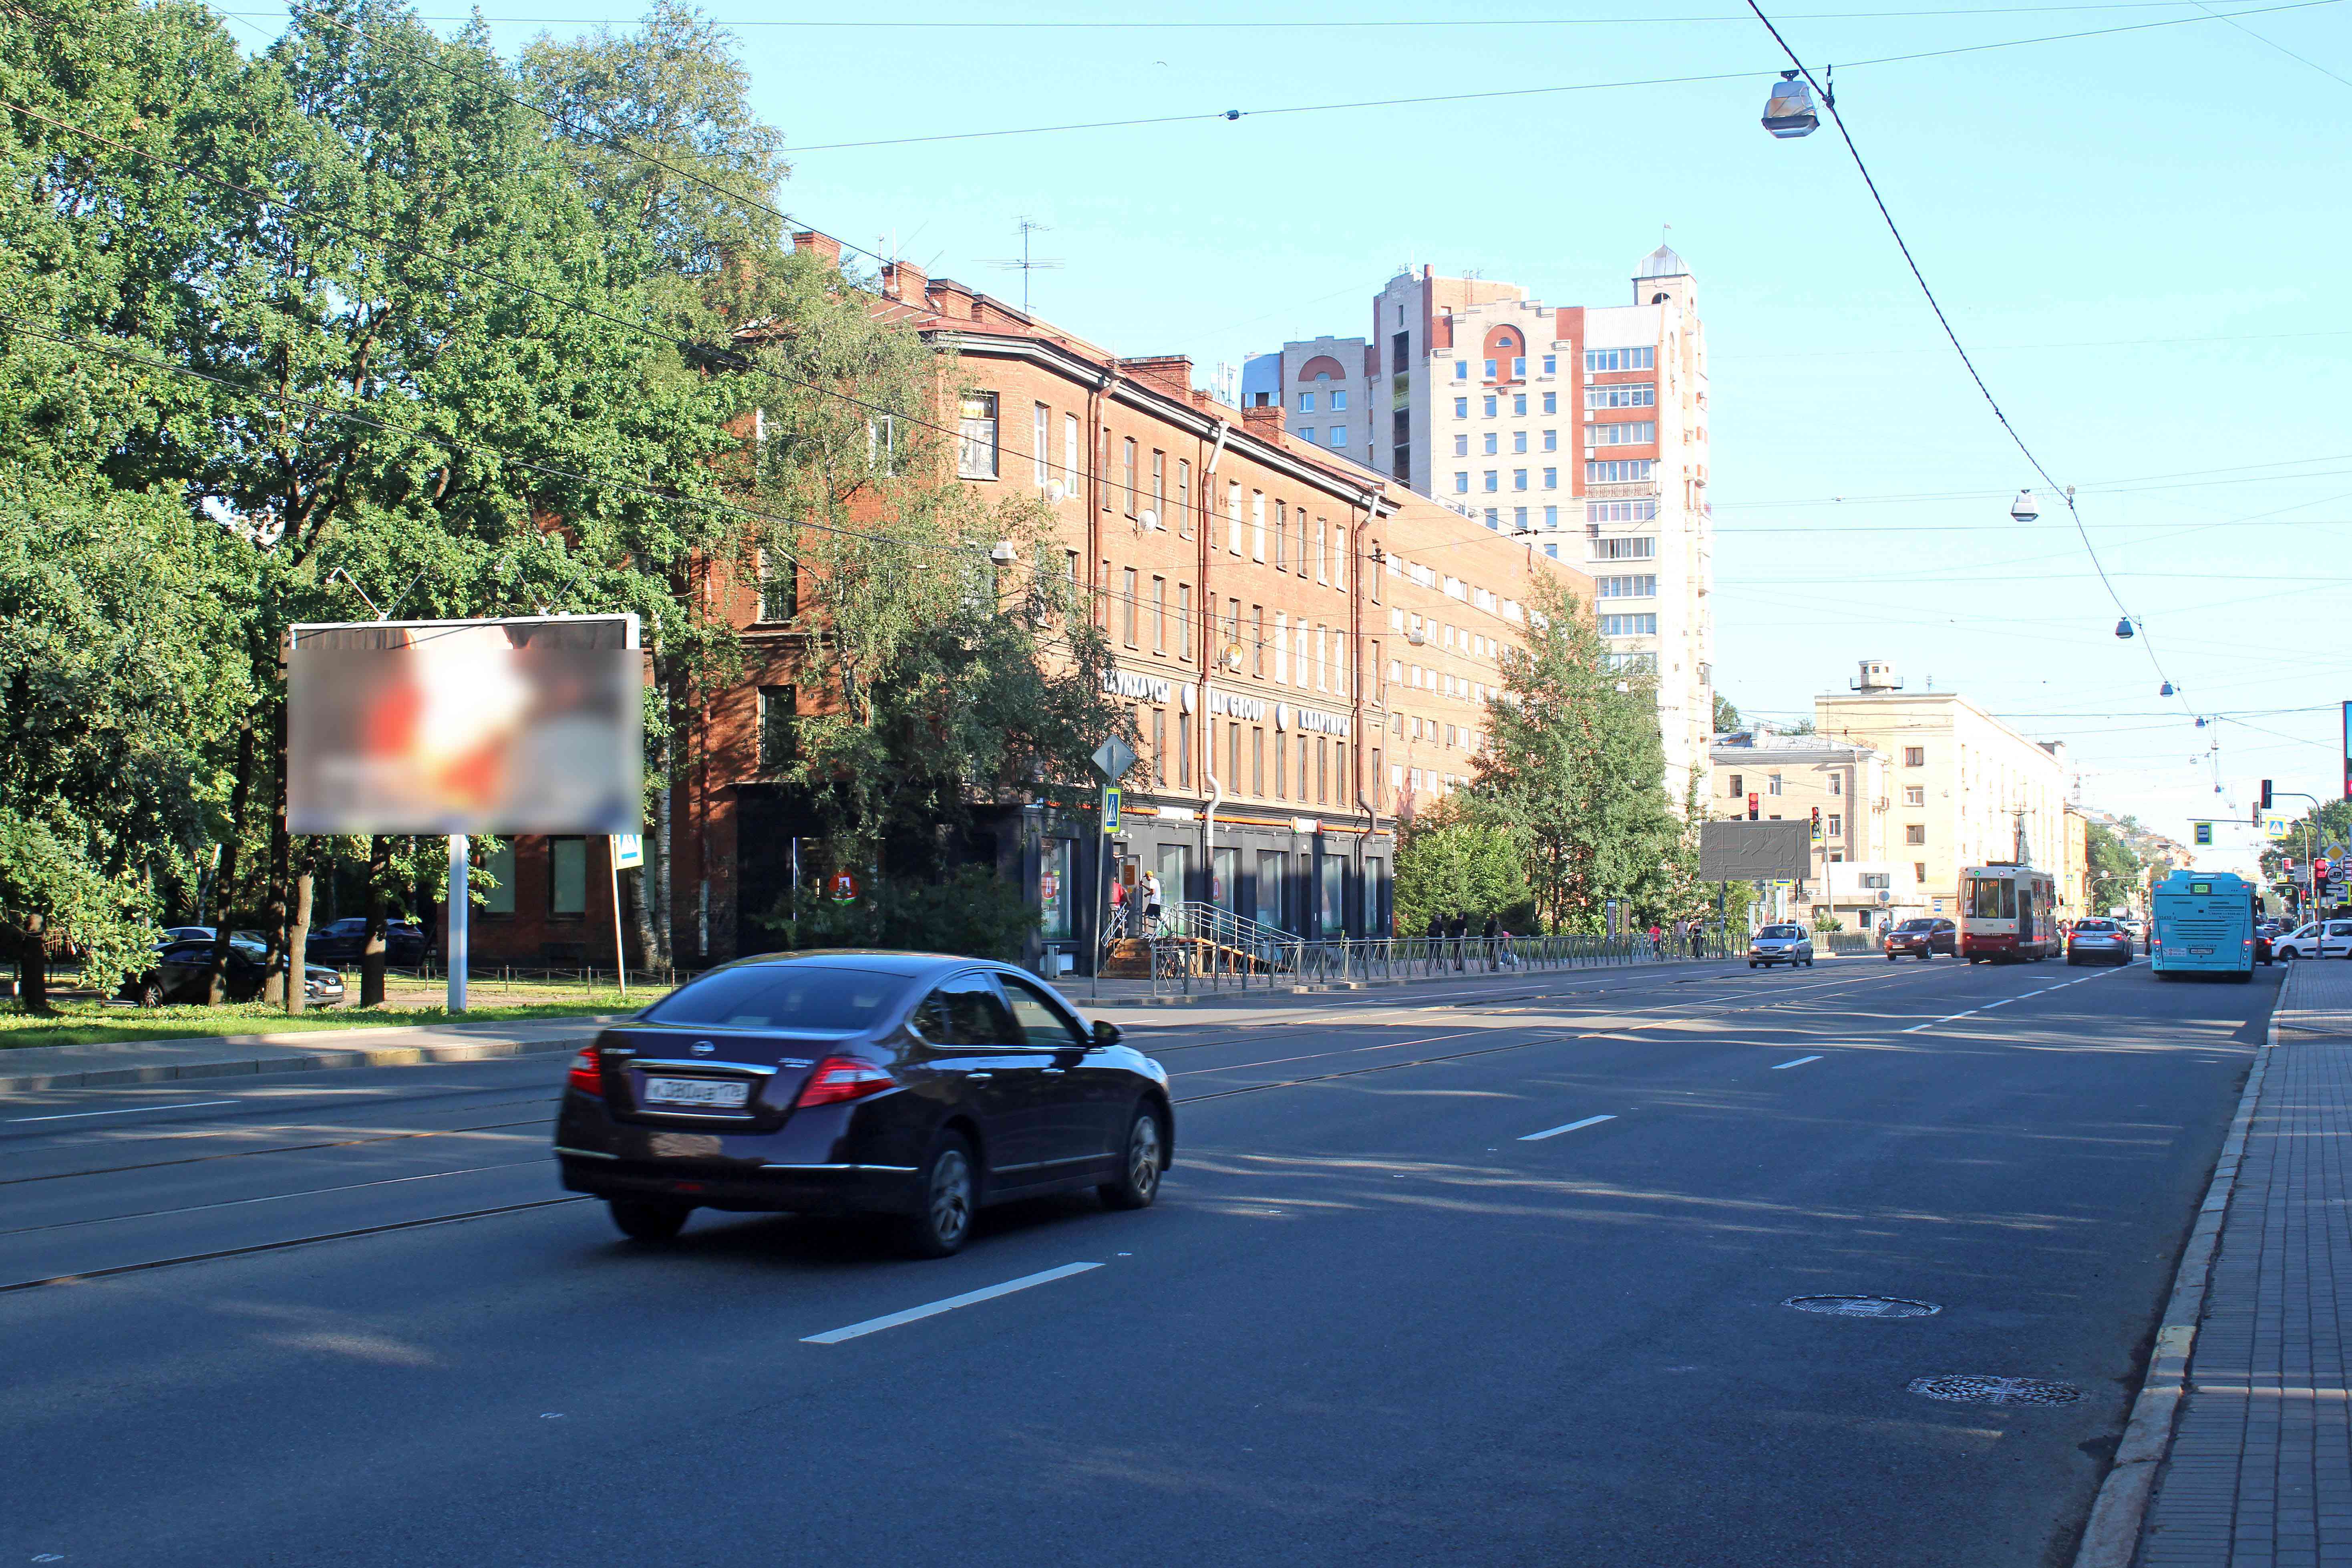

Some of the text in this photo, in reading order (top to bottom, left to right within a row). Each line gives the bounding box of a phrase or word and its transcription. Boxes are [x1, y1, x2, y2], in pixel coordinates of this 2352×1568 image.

[1102, 668, 1171, 704] ТАУНХАУСЫ
[1229, 695, 1266, 721] GROUP
[1299, 709, 1350, 737] КВАРТИРЫ
